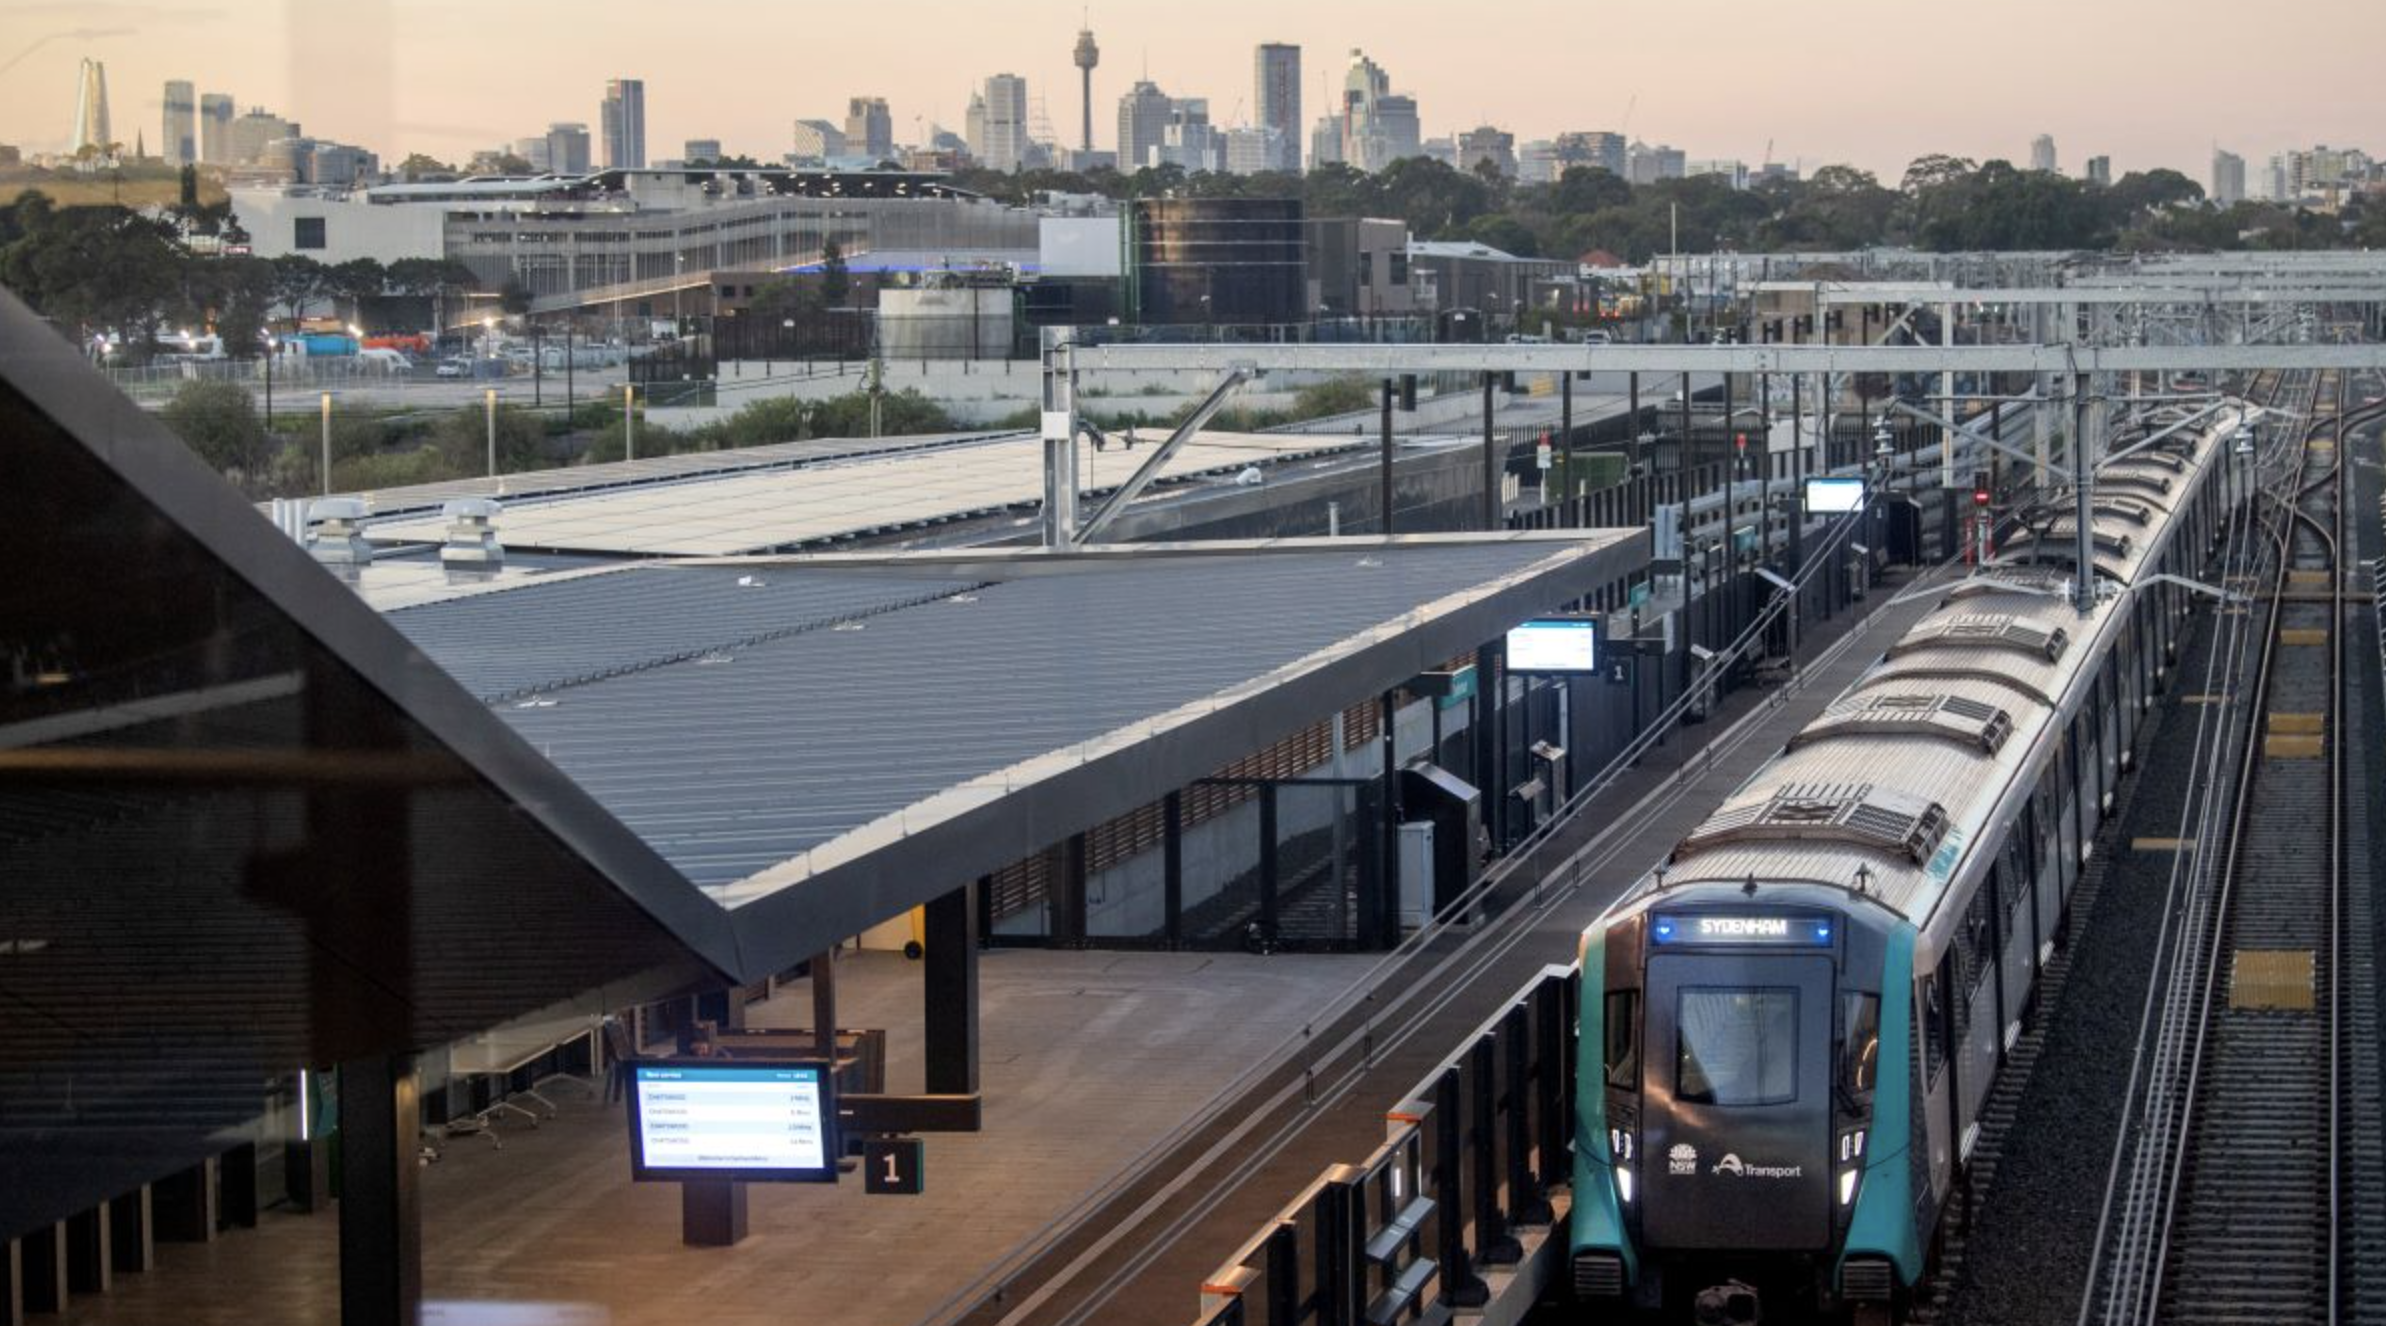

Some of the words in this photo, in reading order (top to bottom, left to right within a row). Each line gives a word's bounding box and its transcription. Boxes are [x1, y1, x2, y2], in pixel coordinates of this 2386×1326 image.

[1614, 665, 1624, 680] 1
[1700, 918, 1788, 935] SYDENHAM
[883, 1153, 900, 1183] 1
[1669, 1161, 1696, 1171] NSW
[1745, 1163, 1801, 1178] Transport
